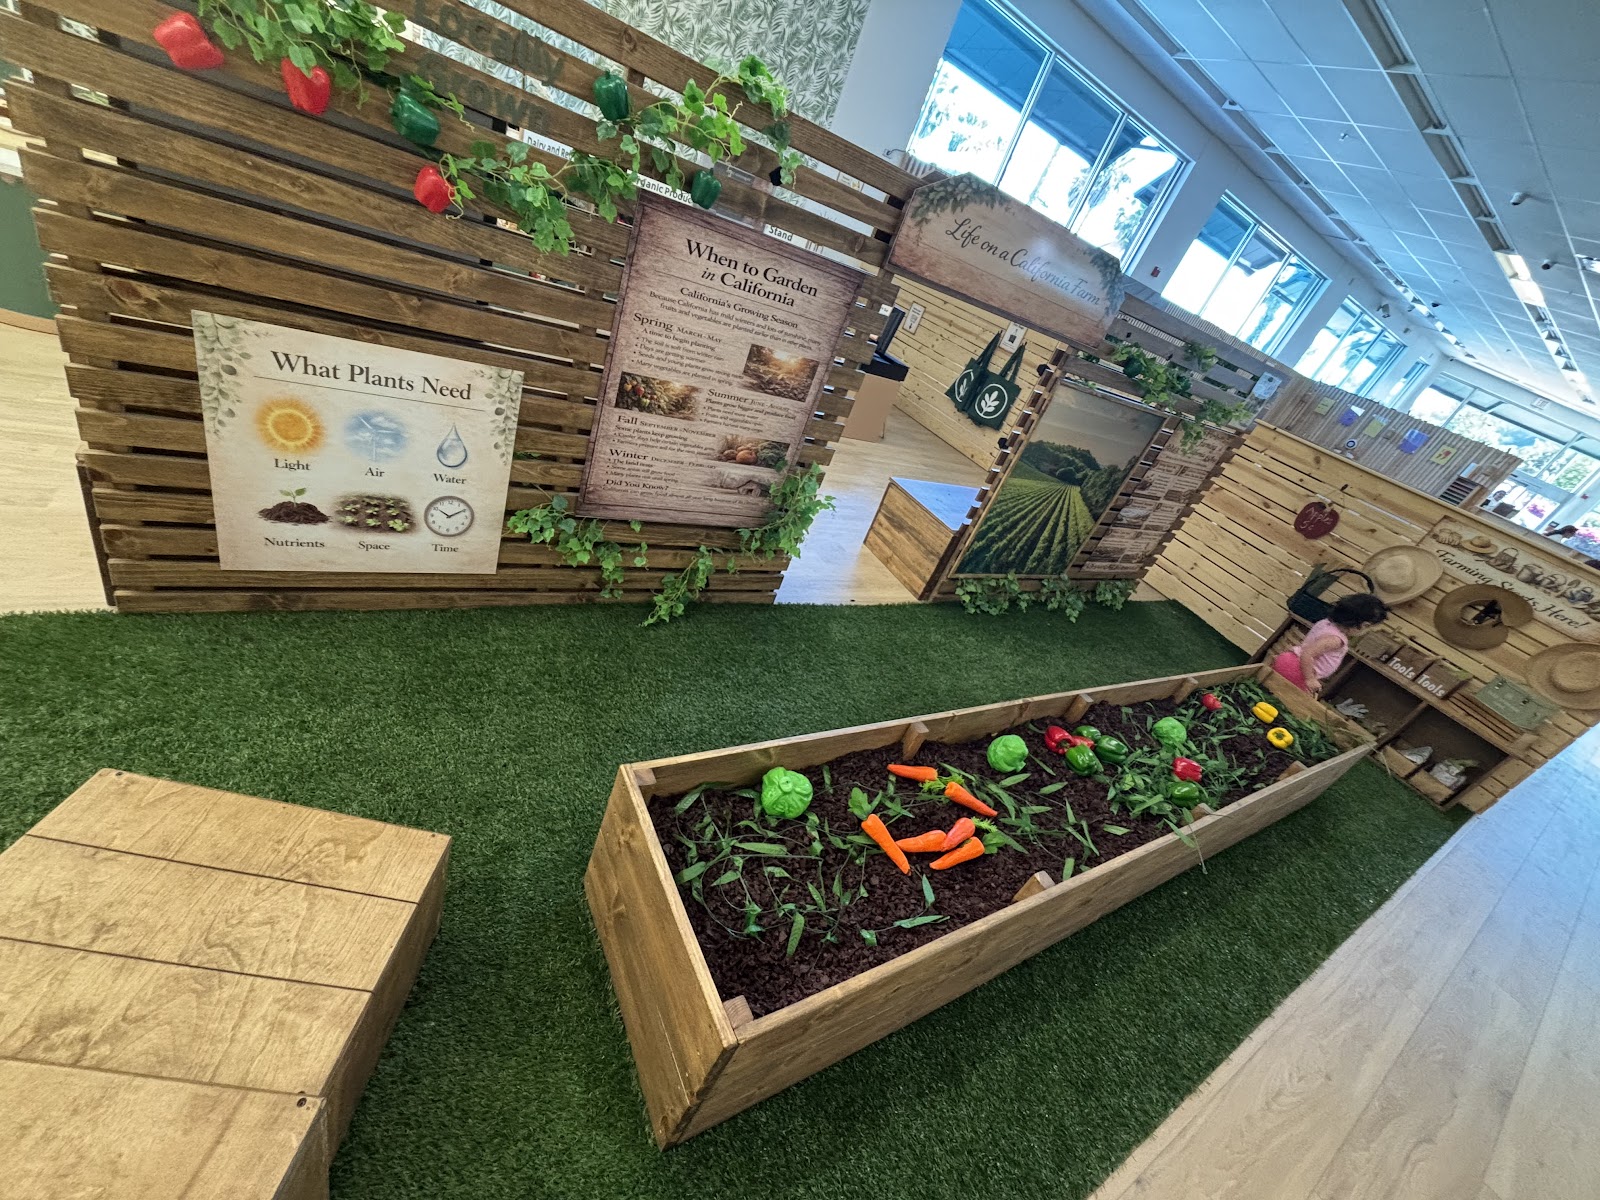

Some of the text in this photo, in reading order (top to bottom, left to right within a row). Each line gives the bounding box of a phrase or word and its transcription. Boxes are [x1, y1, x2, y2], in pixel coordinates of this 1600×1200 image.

[547, 144, 560, 155] and
[635, 177, 692, 204] rganic Produc
[769, 225, 793, 242] Stand
[683, 237, 819, 297] When to Garden
[945, 217, 1101, 306] Life on a California Farm
[701, 264, 796, 306] in California
[649, 291, 676, 304] Because
[676, 299, 708, 313] California
[708, 308, 720, 316] has
[720, 311, 734, 320] mild
[755, 321, 767, 329] and
[766, 324, 777, 332] lots
[659, 302, 677, 313] fruits
[678, 307, 690, 316] and
[690, 311, 722, 325] vegetables
[732, 322, 754, 333] planted
[679, 286, 798, 328] California's Growing Season
[632, 312, 673, 332] Spring
[676, 327, 702, 338] MARCH
[641, 327, 648, 335] A
[648, 329, 664, 339] time
[671, 335, 689, 345] begin
[690, 339, 716, 351] planting
[270, 350, 472, 401] What Plants Need
[707, 388, 748, 403] Summer
[617, 415, 638, 424] Fall
[273, 458, 311, 472] Light
[608, 448, 649, 460] Winter
[364, 467, 385, 478] Air
[433, 473, 467, 485] Water
[642, 482, 668, 490] Know?
[264, 537, 325, 549] Nutrients
[358, 540, 391, 551] Space
[431, 543, 459, 553] Time
[1436, 549, 1494, 584] Farming
[1540, 603, 1592, 629] Here!
[1388, 656, 1416, 679] Tools
[1417, 673, 1445, 697] Tools
